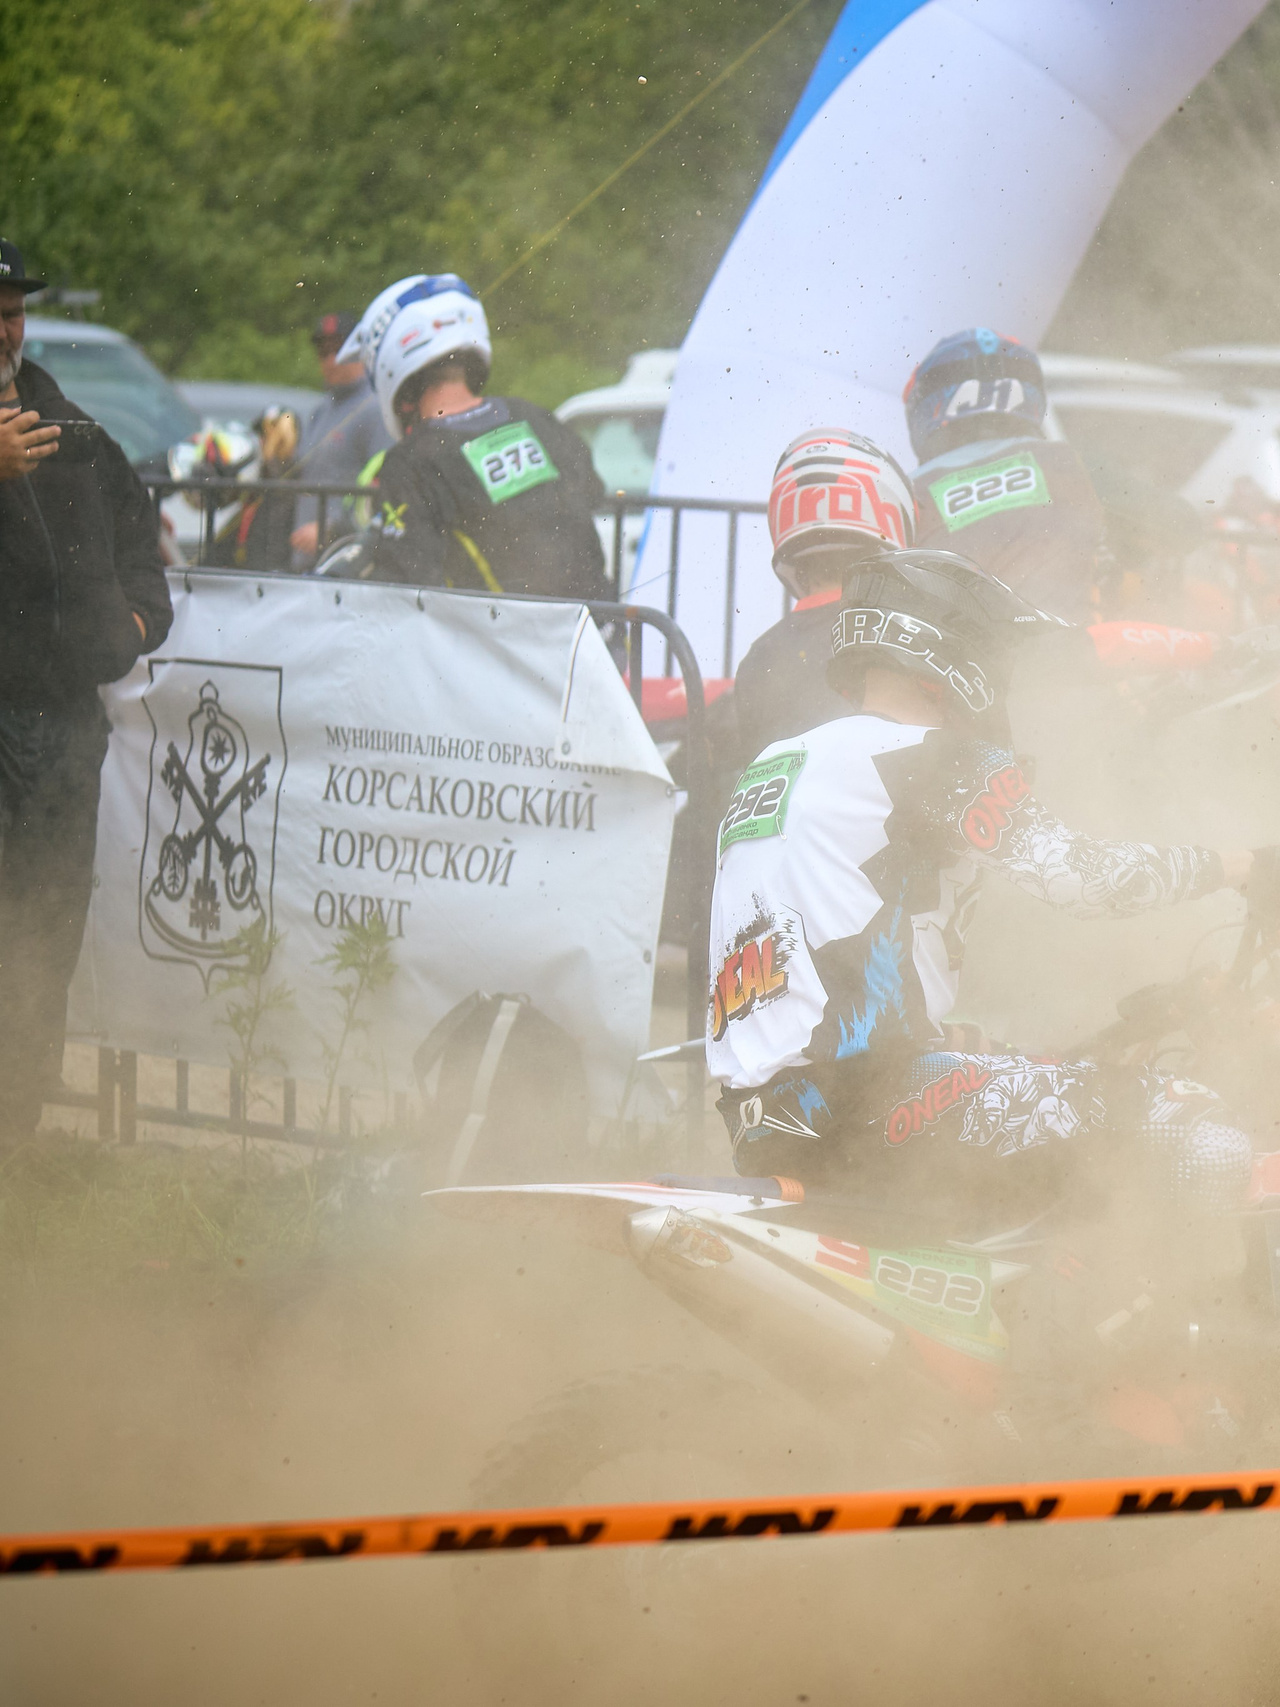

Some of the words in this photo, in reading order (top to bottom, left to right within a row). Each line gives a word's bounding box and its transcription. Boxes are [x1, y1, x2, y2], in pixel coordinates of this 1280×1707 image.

[483, 440, 545, 486] 272
[944, 466, 1034, 517] 222
[325, 725, 484, 762] МУНИЦИПАЛЬНОЕ
[488, 741, 622, 776] ОБРАЗО
[322, 763, 597, 831] КОРСАКОВСКИЙ
[723, 775, 788, 836] 292
[316, 826, 516, 887] ГОРОДСКОЙ
[314, 889, 412, 938] ОКРУГ
[888, 1064, 990, 1144] ONEAL
[876, 1256, 985, 1316] 292
